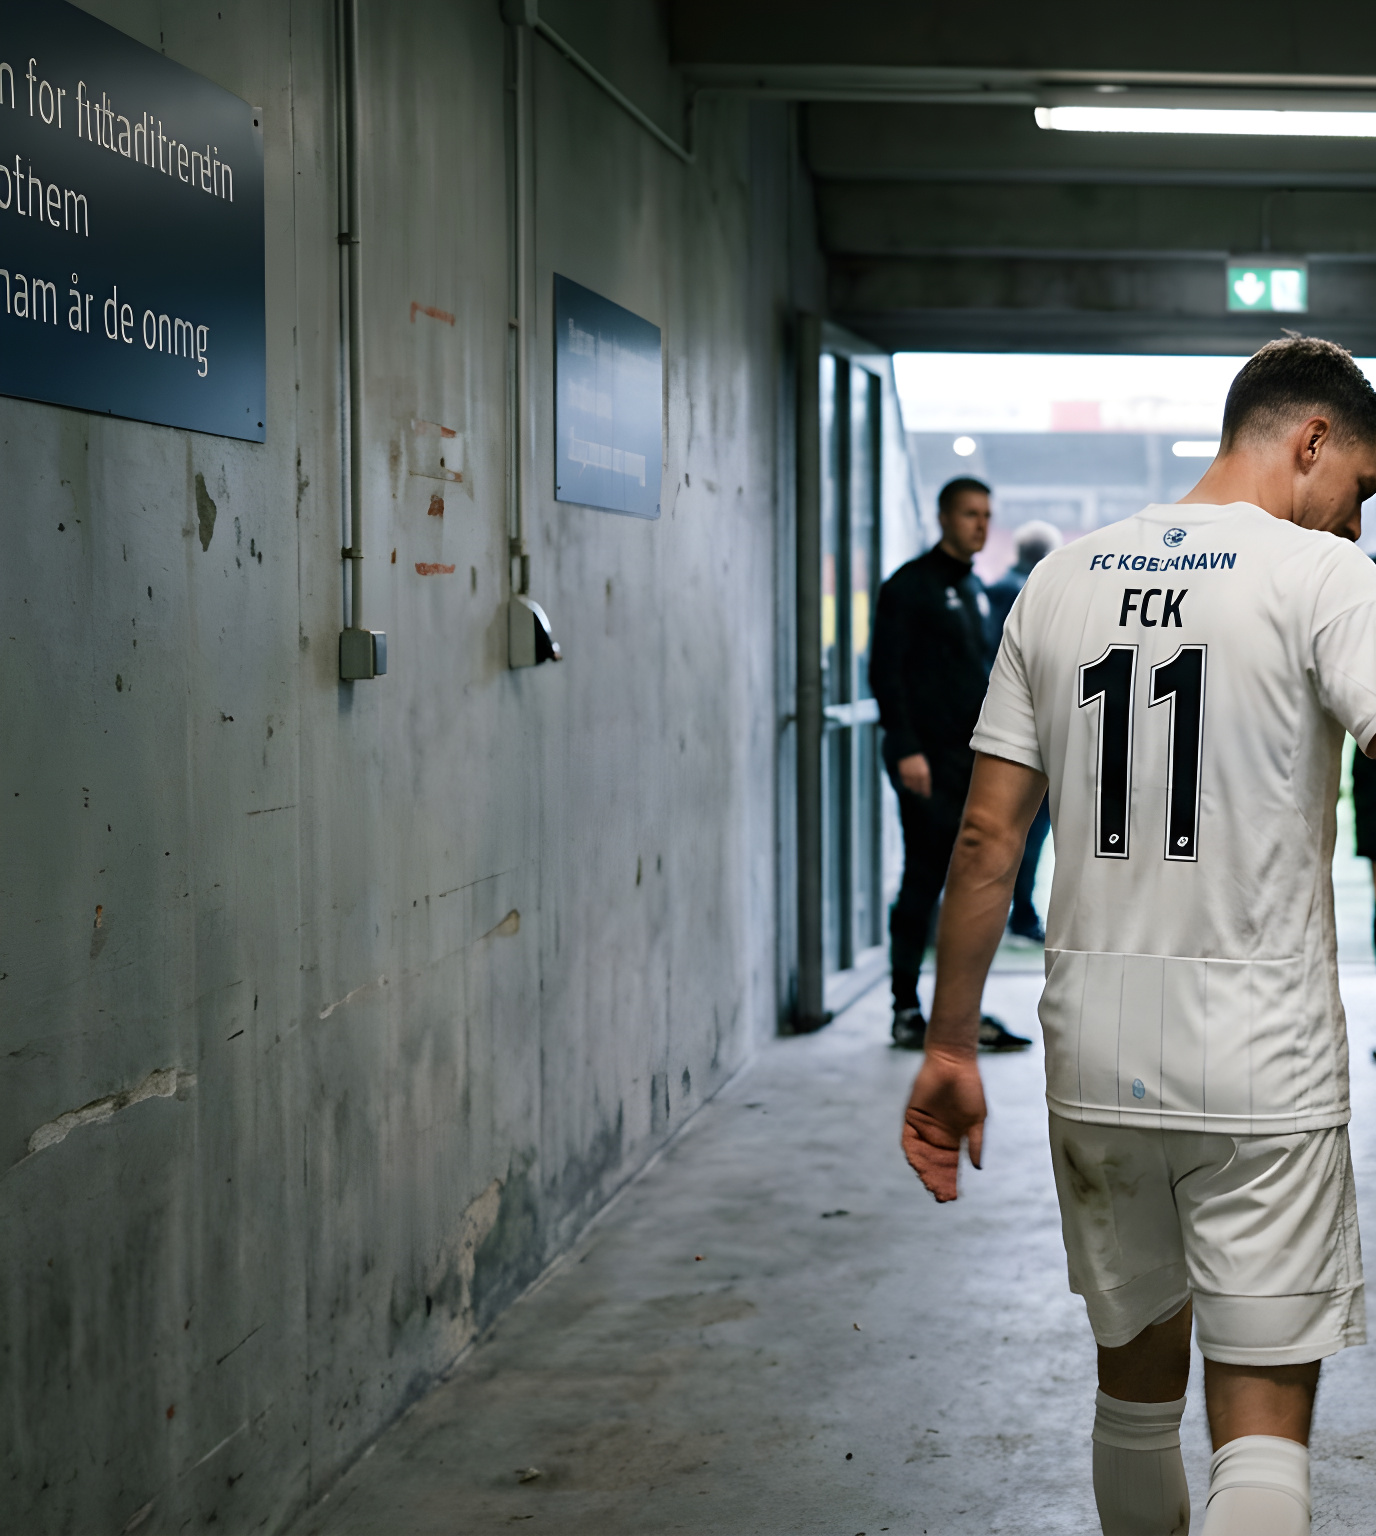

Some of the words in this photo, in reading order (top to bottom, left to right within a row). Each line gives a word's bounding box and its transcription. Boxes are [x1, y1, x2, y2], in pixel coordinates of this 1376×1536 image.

[26, 57, 66, 129] for
[68, 272, 94, 334] år
[104, 285, 134, 344] de
[1090, 553, 1115, 571] FC
[1119, 588, 1189, 628] FCK
[1078, 643, 1208, 862] 11
